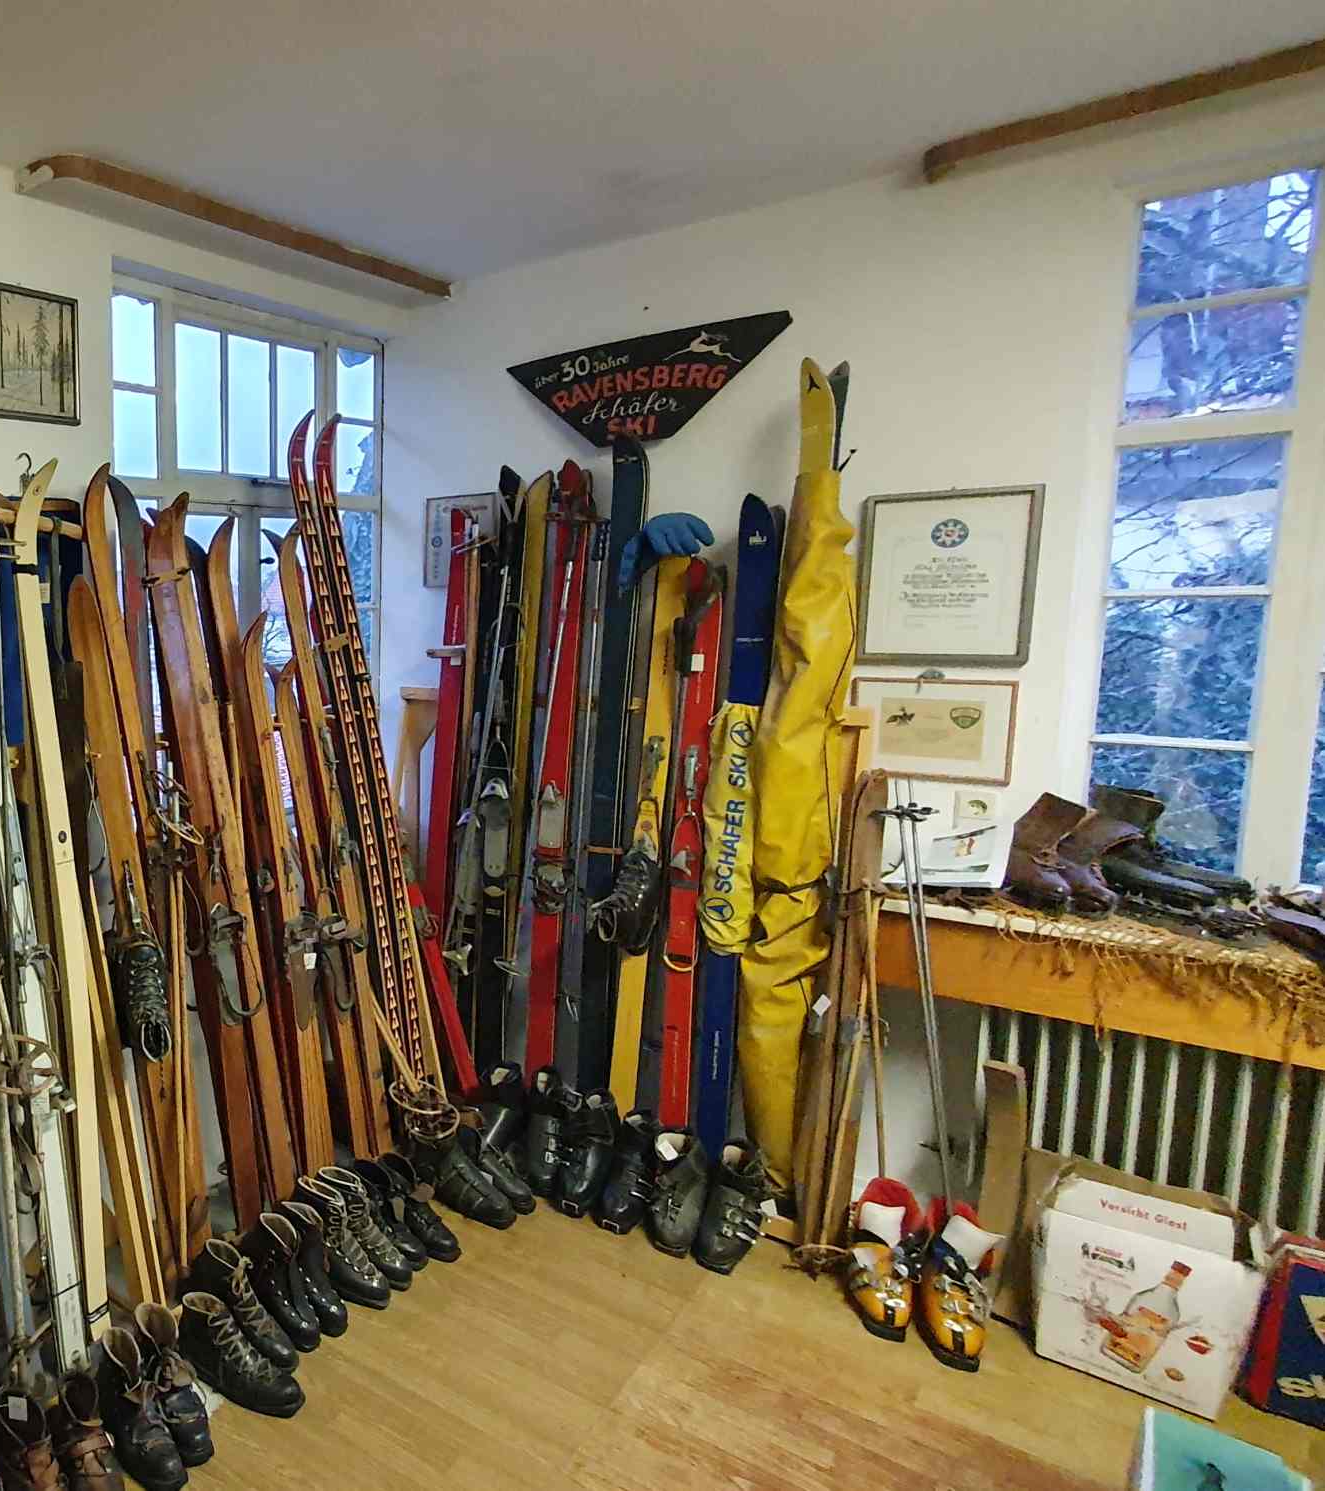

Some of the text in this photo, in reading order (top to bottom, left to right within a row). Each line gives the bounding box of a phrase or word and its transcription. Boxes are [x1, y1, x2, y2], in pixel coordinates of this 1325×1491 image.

[561, 354, 591, 383] 30
[592, 354, 630, 374] Jahre
[551, 362, 729, 413] RAVENSBERG
[582, 391, 685, 424] Schäfer
[606, 415, 657, 440] SKI
[728, 753, 748, 789] SKI
[1099, 1198, 1150, 1220] Vorsicht
